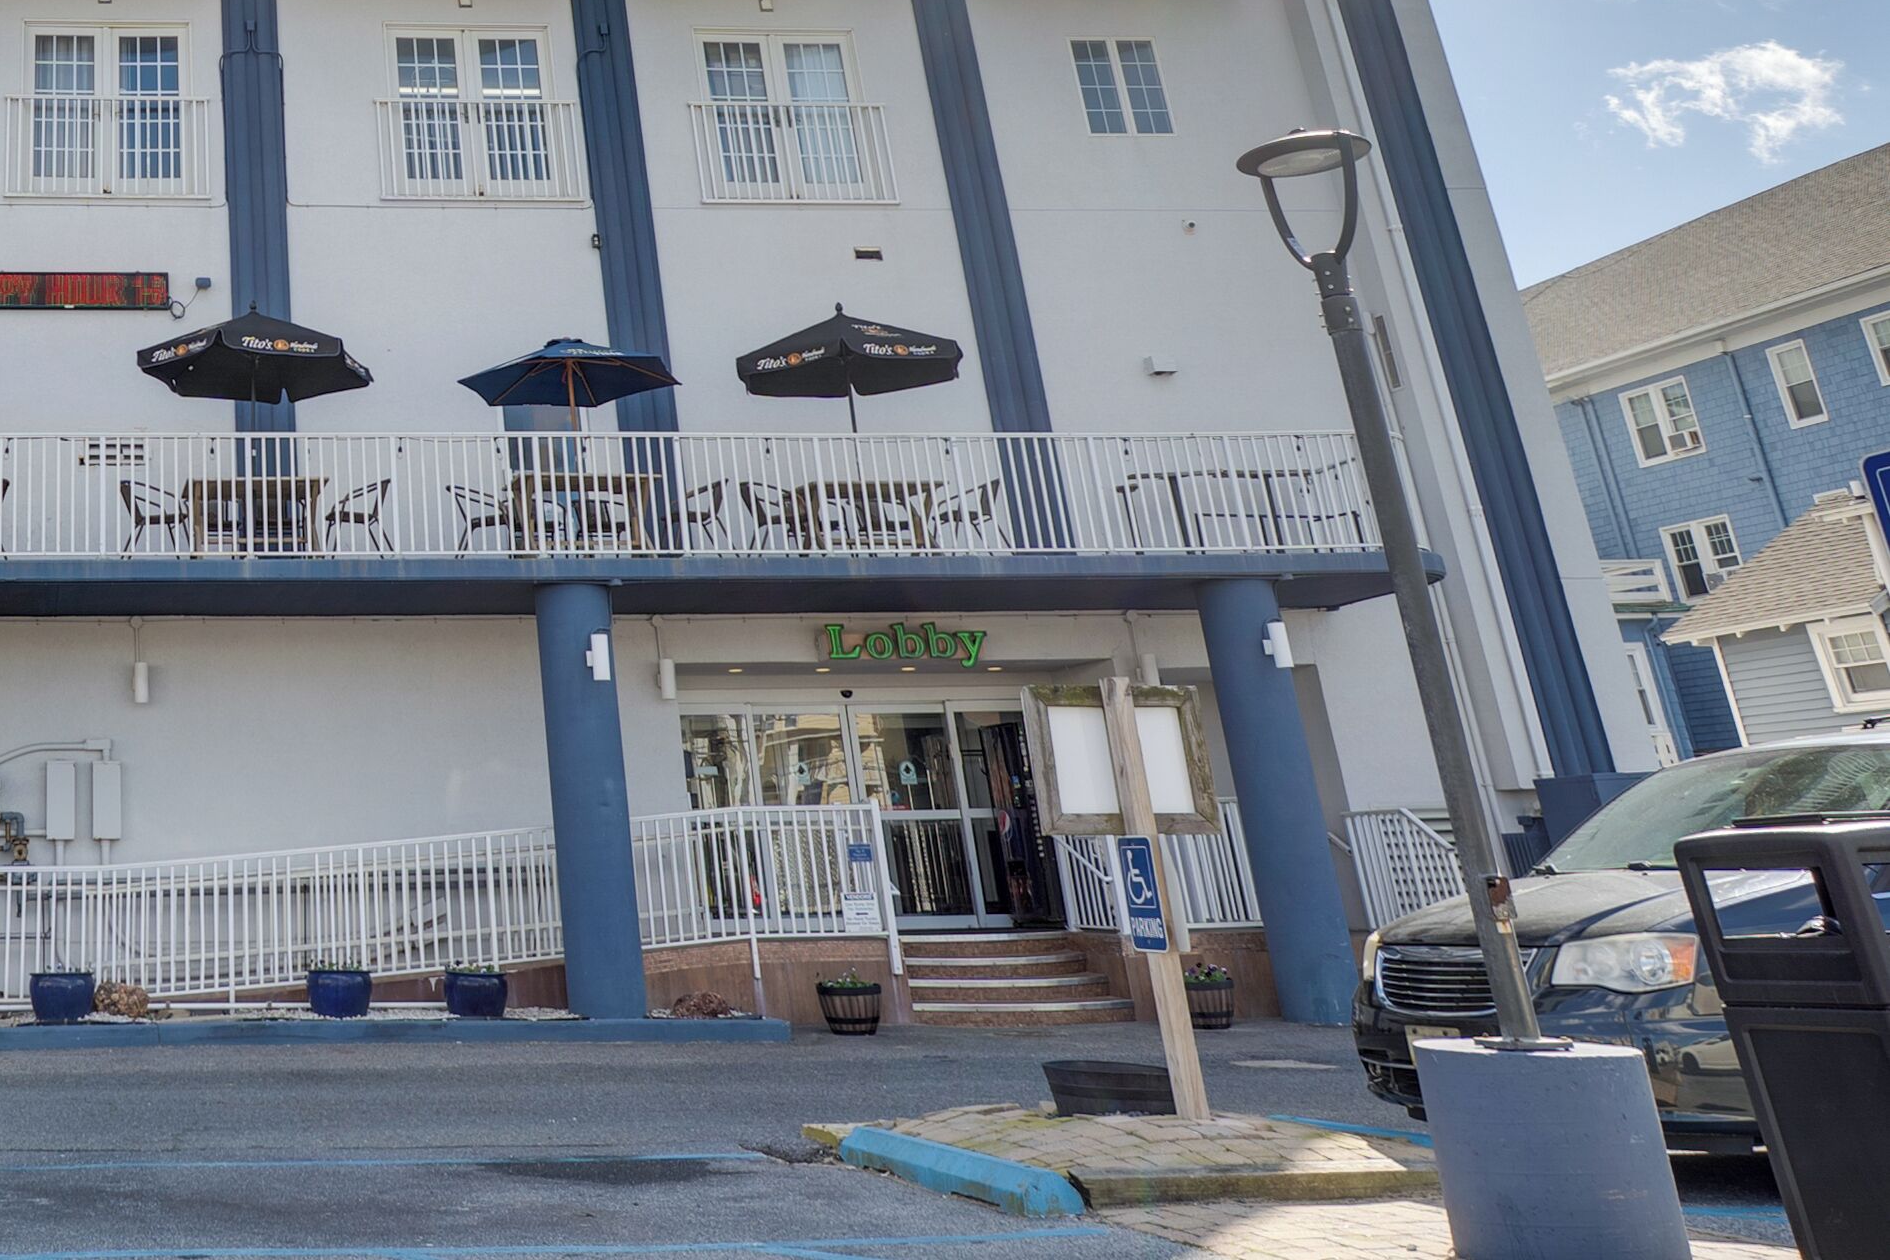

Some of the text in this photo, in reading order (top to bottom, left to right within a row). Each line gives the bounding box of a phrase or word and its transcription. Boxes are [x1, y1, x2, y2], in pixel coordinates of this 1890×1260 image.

[241, 336, 273, 351] Tito's
[863, 343, 894, 355] Tito's
[824, 622, 987, 668] Lobby
[1130, 917, 1164, 939] PARKING
